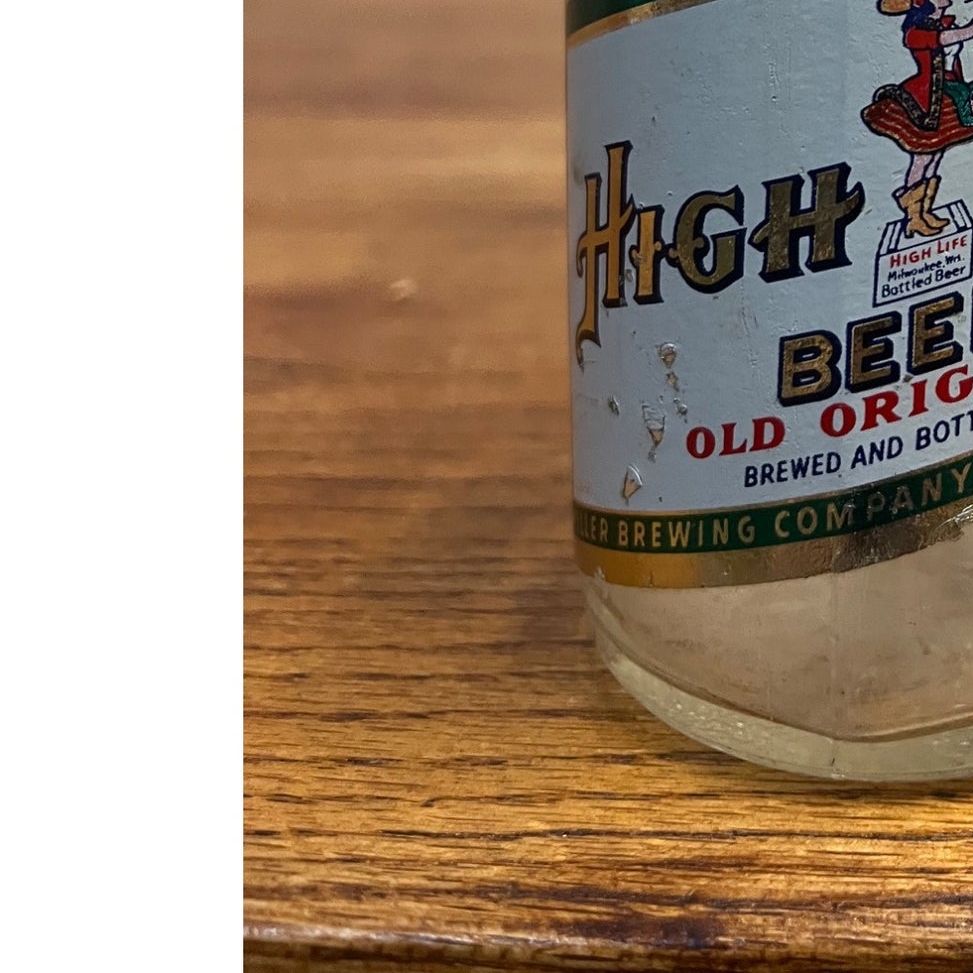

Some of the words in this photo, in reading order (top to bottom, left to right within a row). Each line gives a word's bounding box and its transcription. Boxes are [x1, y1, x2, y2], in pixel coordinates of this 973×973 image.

[576, 140, 865, 372] HIGH
[889, 246, 931, 268] HIGH
[937, 234, 968, 254] LIFE
[882, 274, 932, 298] Bottled
[935, 265, 966, 282] Beer
[686, 416, 785, 459] OLD
[744, 451, 842, 488] BREWED
[851, 436, 904, 469] AND
[618, 515, 755, 547] BREWING
